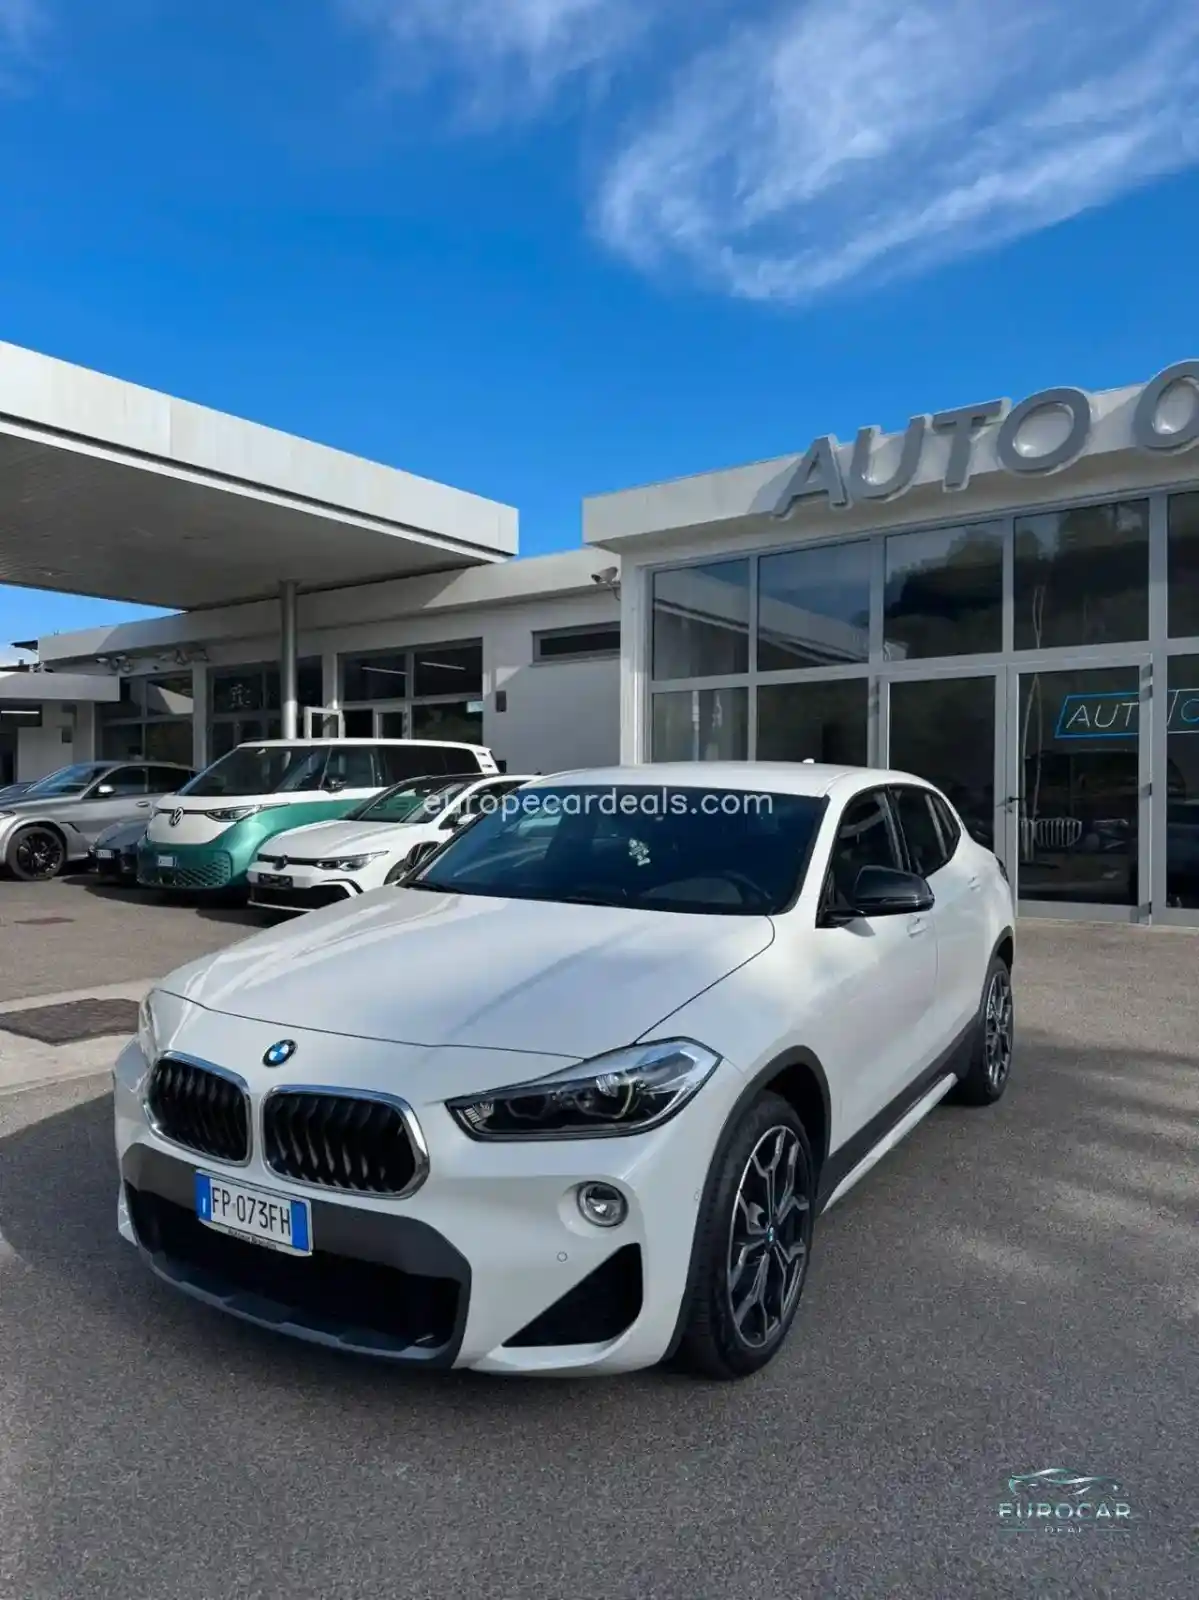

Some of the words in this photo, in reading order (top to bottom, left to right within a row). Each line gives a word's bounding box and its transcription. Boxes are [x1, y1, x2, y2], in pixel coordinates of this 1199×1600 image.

[770, 386, 1092, 520] AUTO
[1066, 702, 1140, 729] AUT
[211, 1186, 231, 1217] FP
[236, 1194, 291, 1236] 073FH
